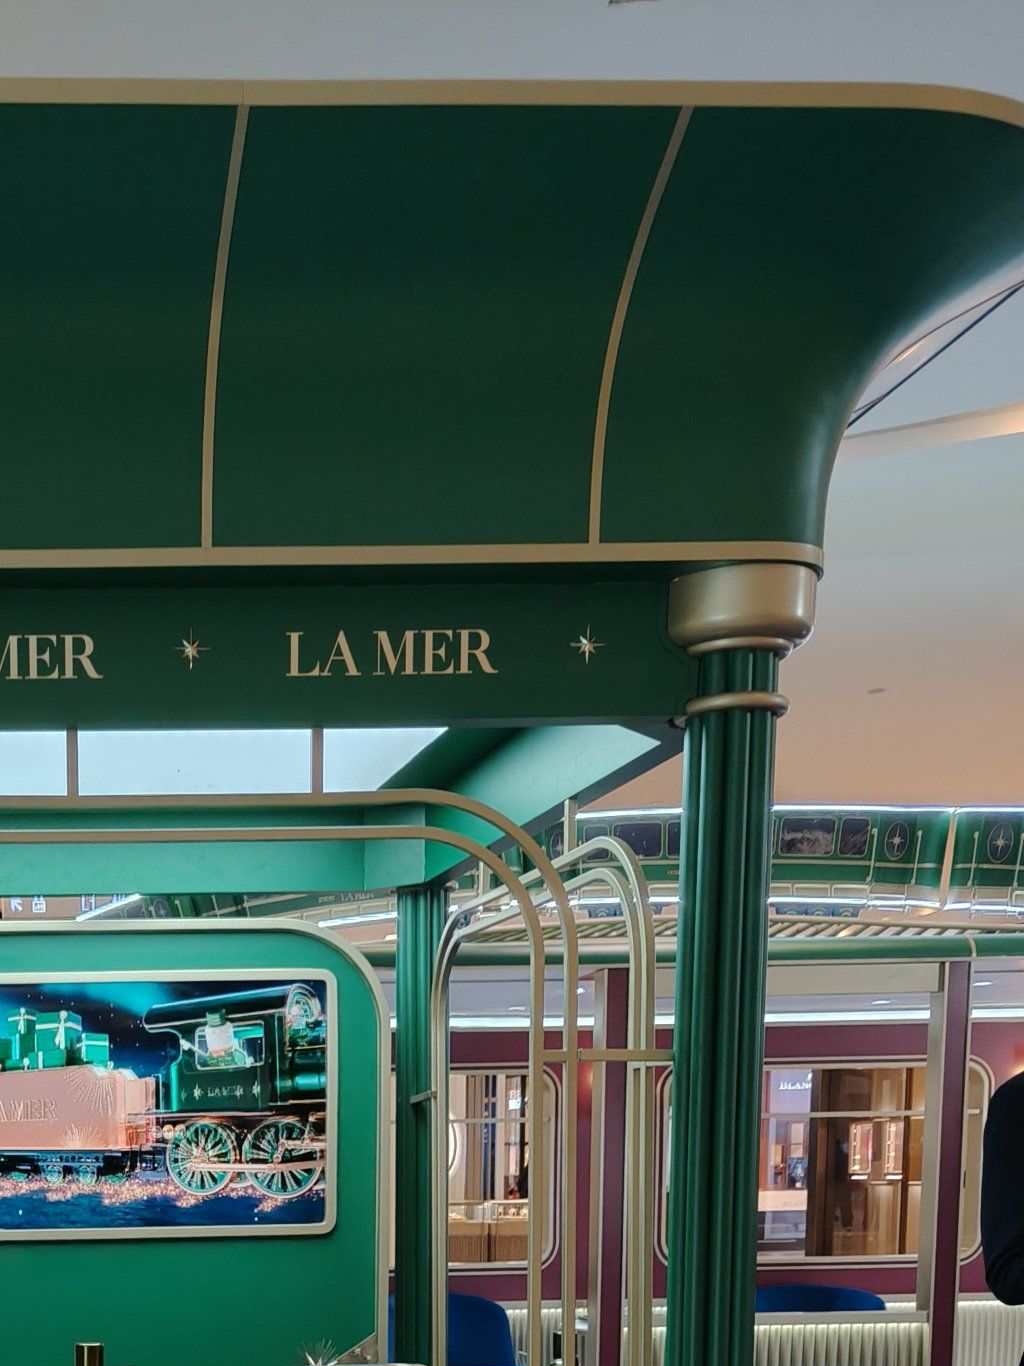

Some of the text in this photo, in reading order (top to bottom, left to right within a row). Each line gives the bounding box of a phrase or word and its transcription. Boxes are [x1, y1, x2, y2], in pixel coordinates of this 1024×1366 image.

[285, 628, 499, 677] LA MER
[10, 1099, 58, 1122] MER
